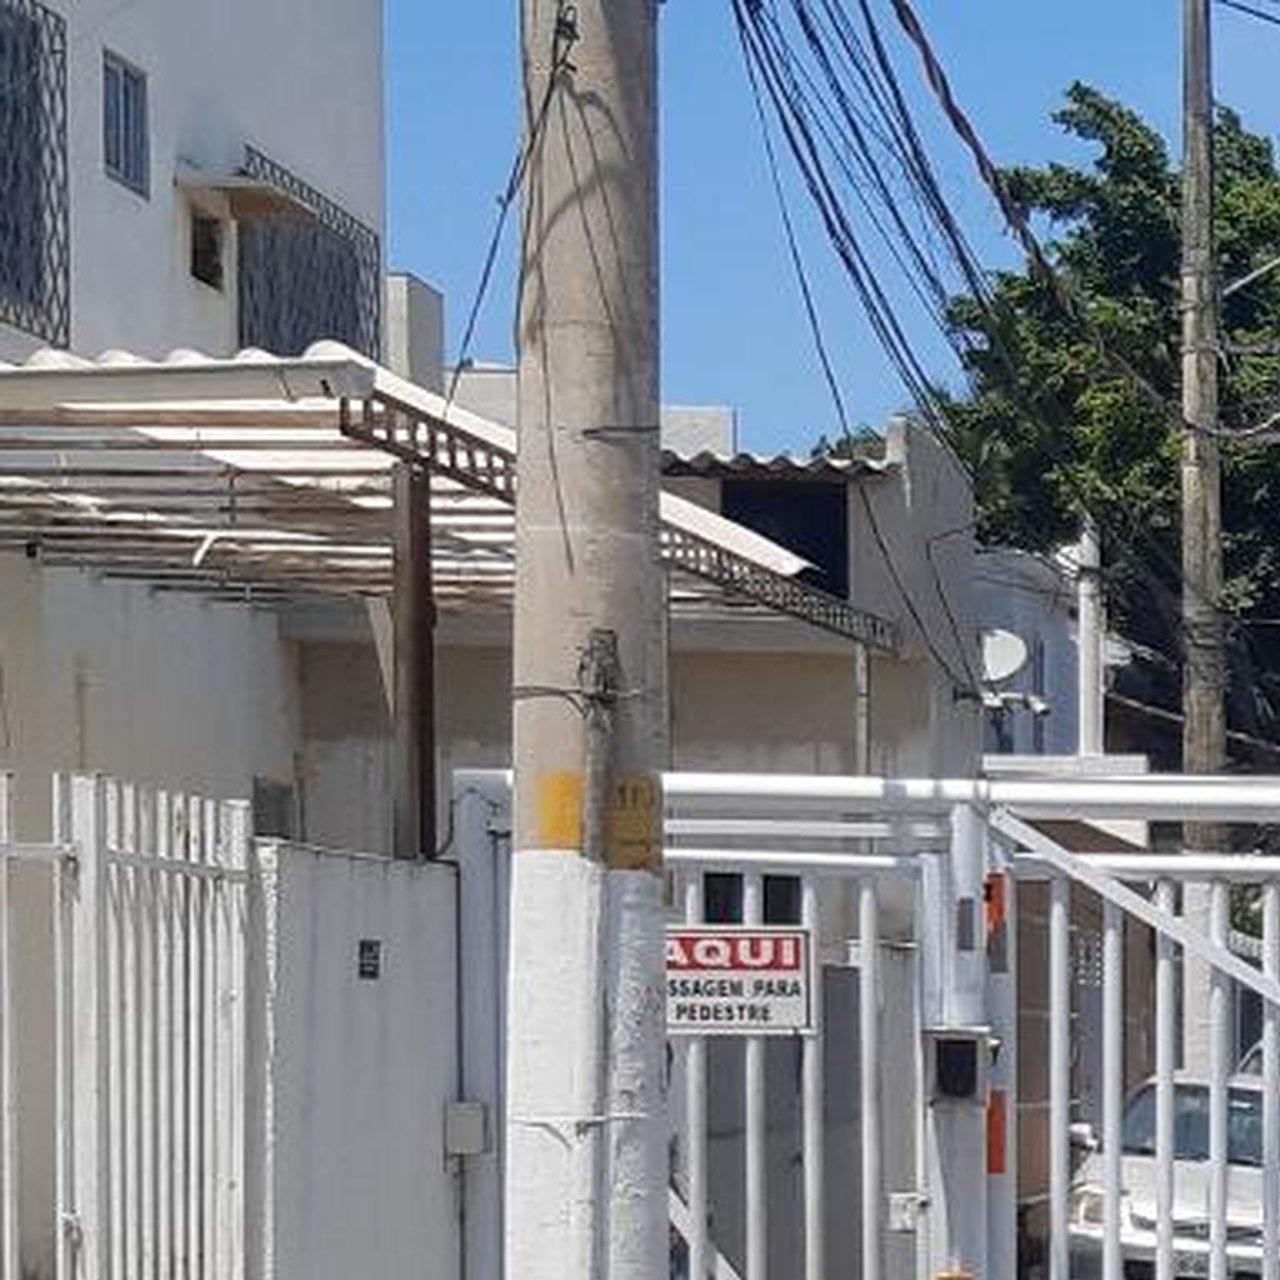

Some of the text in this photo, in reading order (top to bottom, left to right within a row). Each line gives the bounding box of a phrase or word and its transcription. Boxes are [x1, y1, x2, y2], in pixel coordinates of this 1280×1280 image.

[666, 938, 797, 967] AQUI
[668, 978, 801, 998] SSAGEM PARA
[675, 1003, 772, 1022] PEDESTRE
